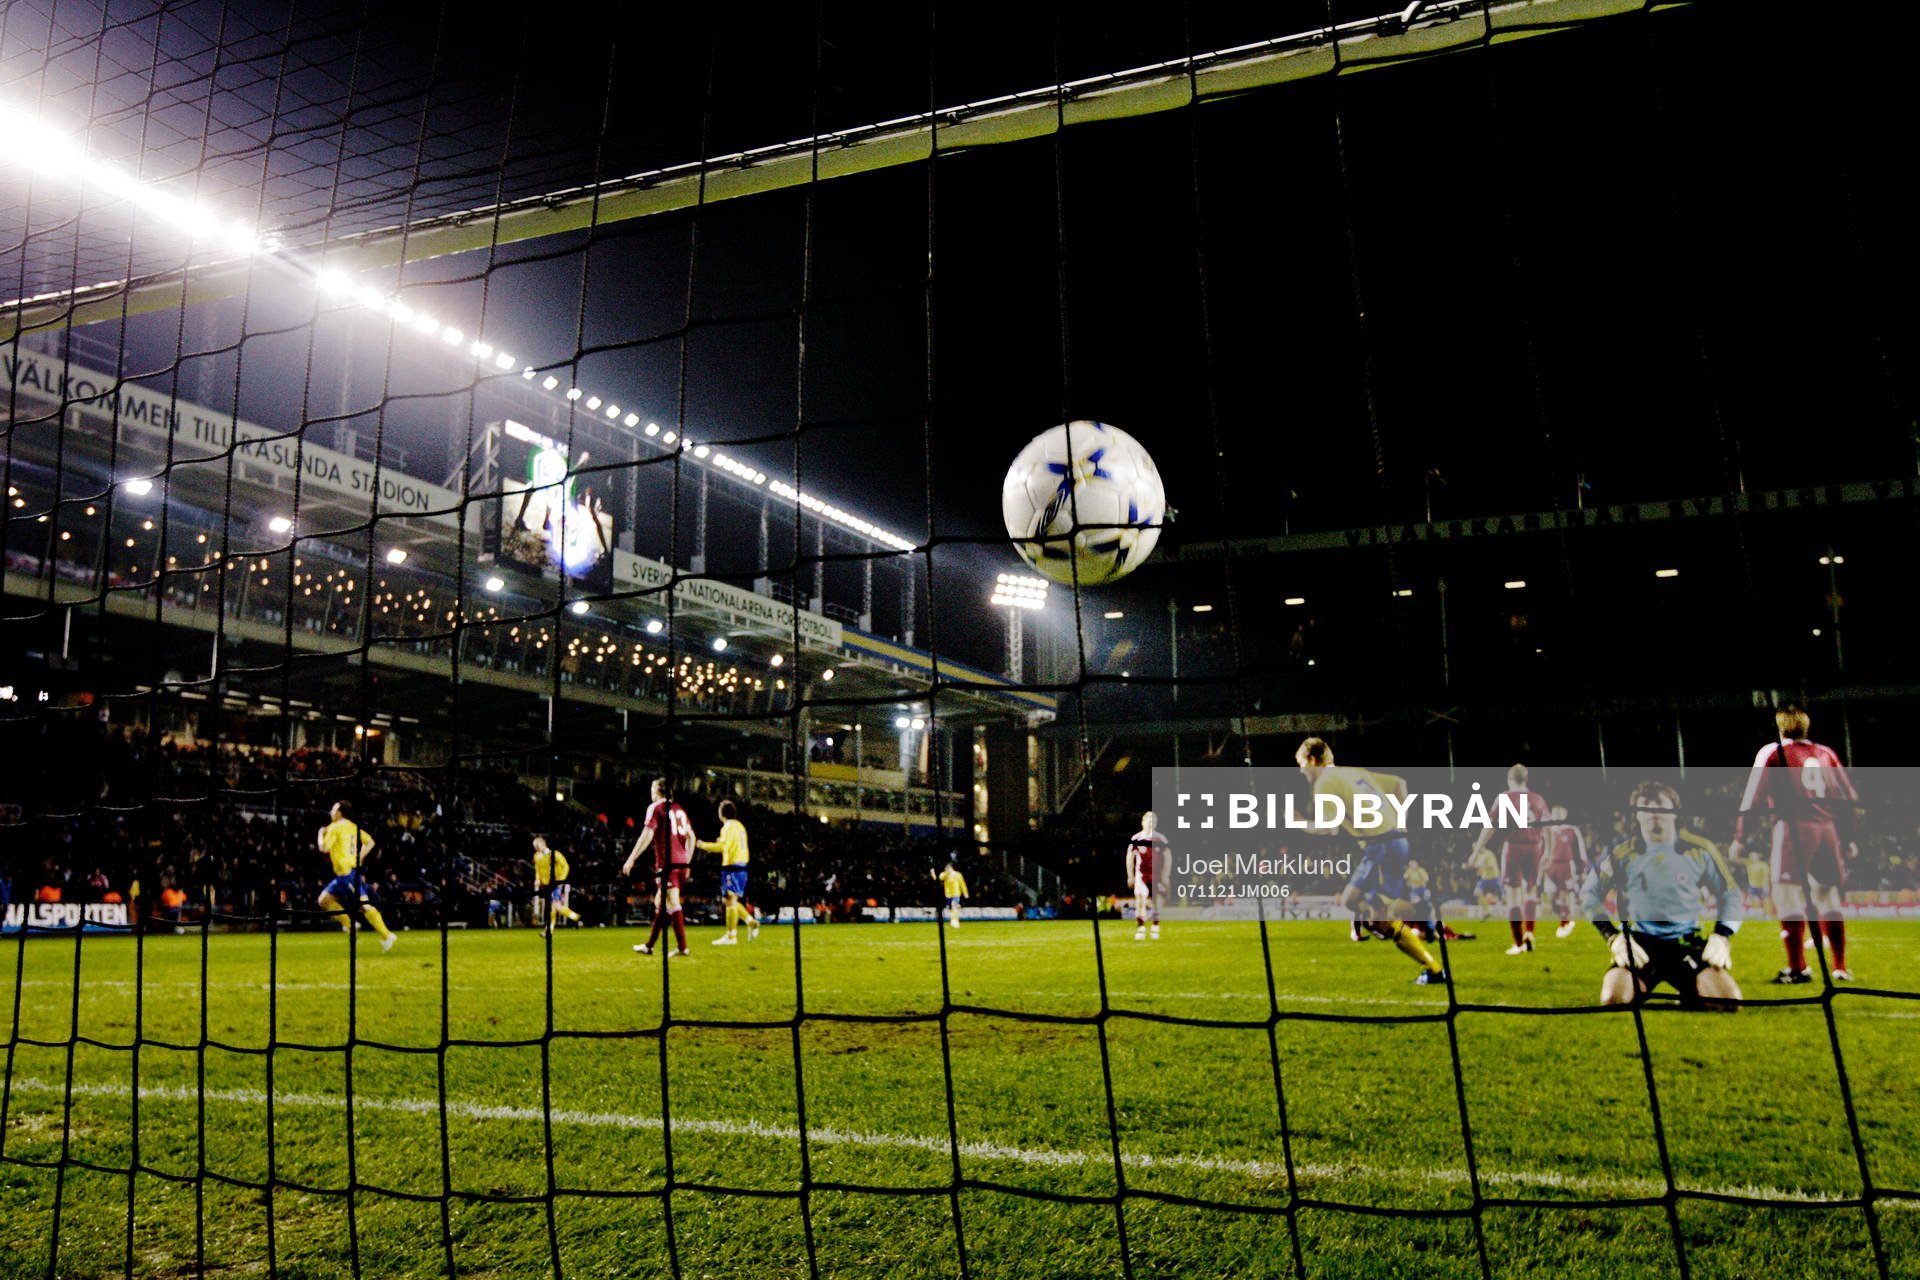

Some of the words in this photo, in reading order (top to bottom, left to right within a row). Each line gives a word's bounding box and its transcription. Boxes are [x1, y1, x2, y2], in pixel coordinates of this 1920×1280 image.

[3, 354, 181, 433] VÄLKOMMEN
[192, 415, 231, 449] TILL
[351, 469, 430, 511] STADION
[631, 561, 685, 593] SVERIGS
[688, 580, 774, 619] NATIONALARENA
